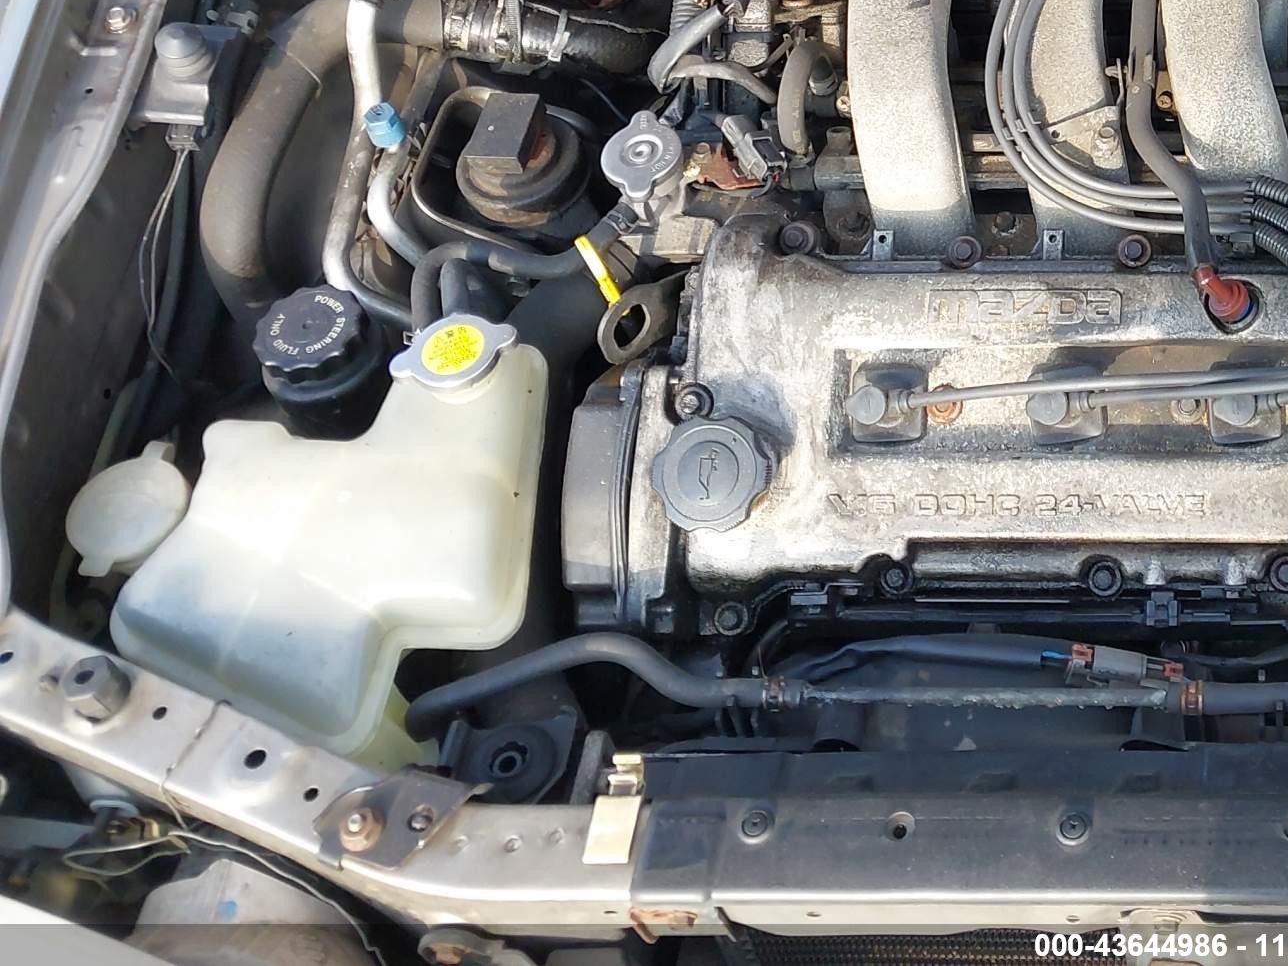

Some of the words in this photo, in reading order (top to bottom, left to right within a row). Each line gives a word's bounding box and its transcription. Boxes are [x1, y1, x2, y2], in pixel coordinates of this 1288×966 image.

[315, 294, 345, 315] POWER
[270, 313, 285, 336] ONLY
[305, 317, 346, 354] STEERING
[272, 338, 301, 355] FLUID
[914, 493, 1022, 516] DOHC
[1034, 493, 1207, 517] 24-VALVE
